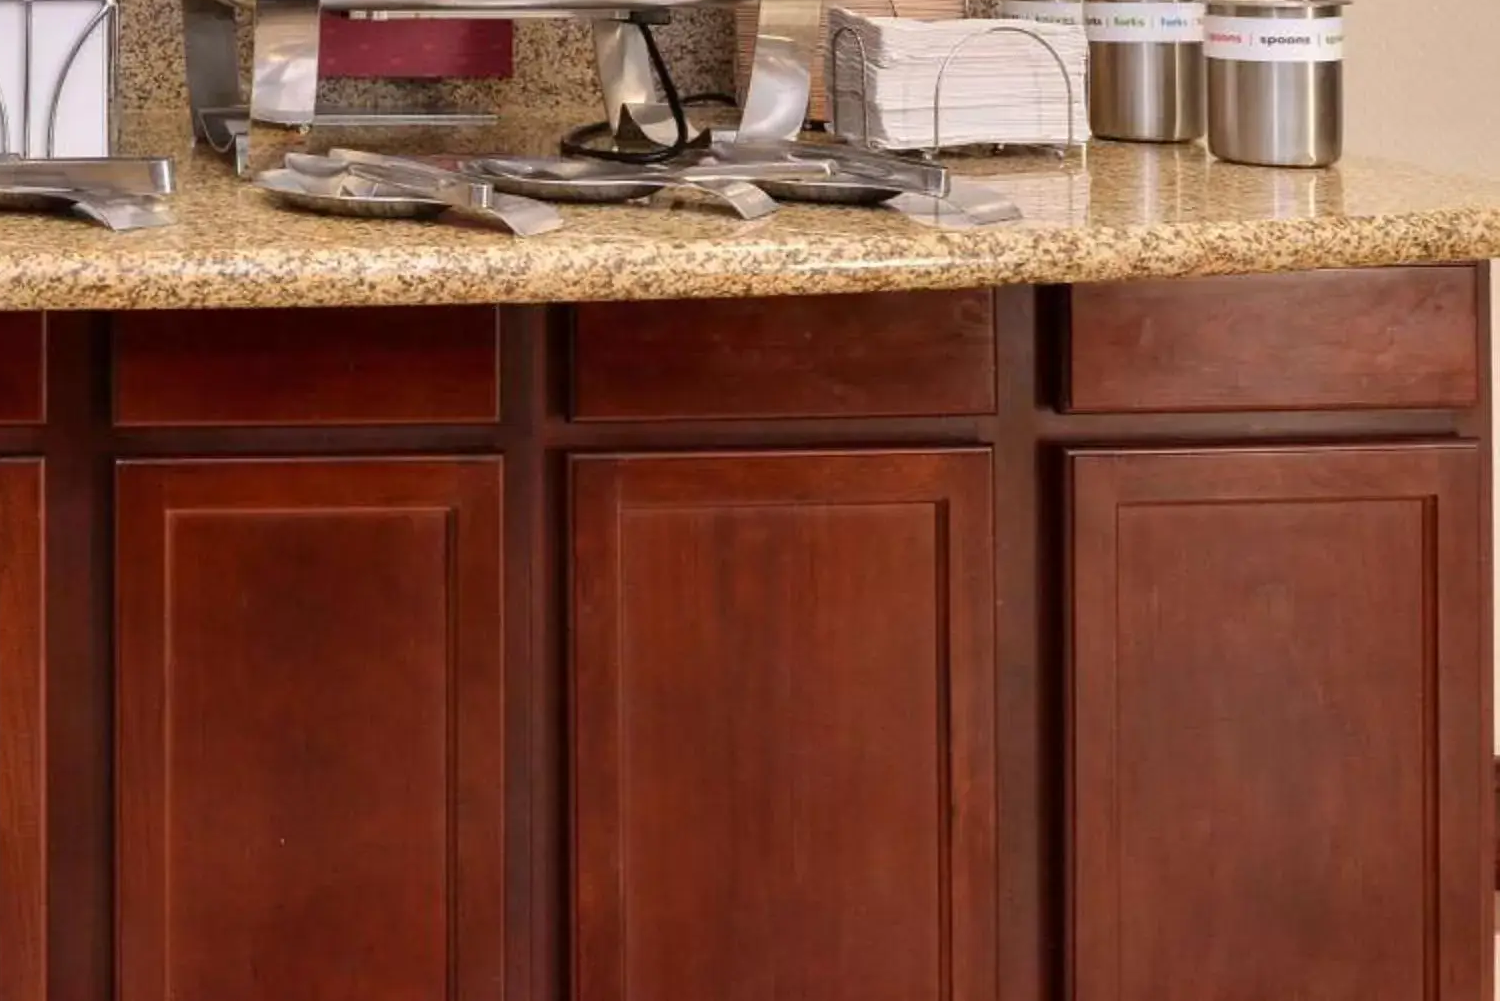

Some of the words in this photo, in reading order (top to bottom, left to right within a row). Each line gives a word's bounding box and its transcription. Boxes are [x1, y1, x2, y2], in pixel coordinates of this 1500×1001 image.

[1115, 16, 1146, 27] forks
[1160, 16, 1188, 27] forks
[1260, 35, 1311, 46] spoons
